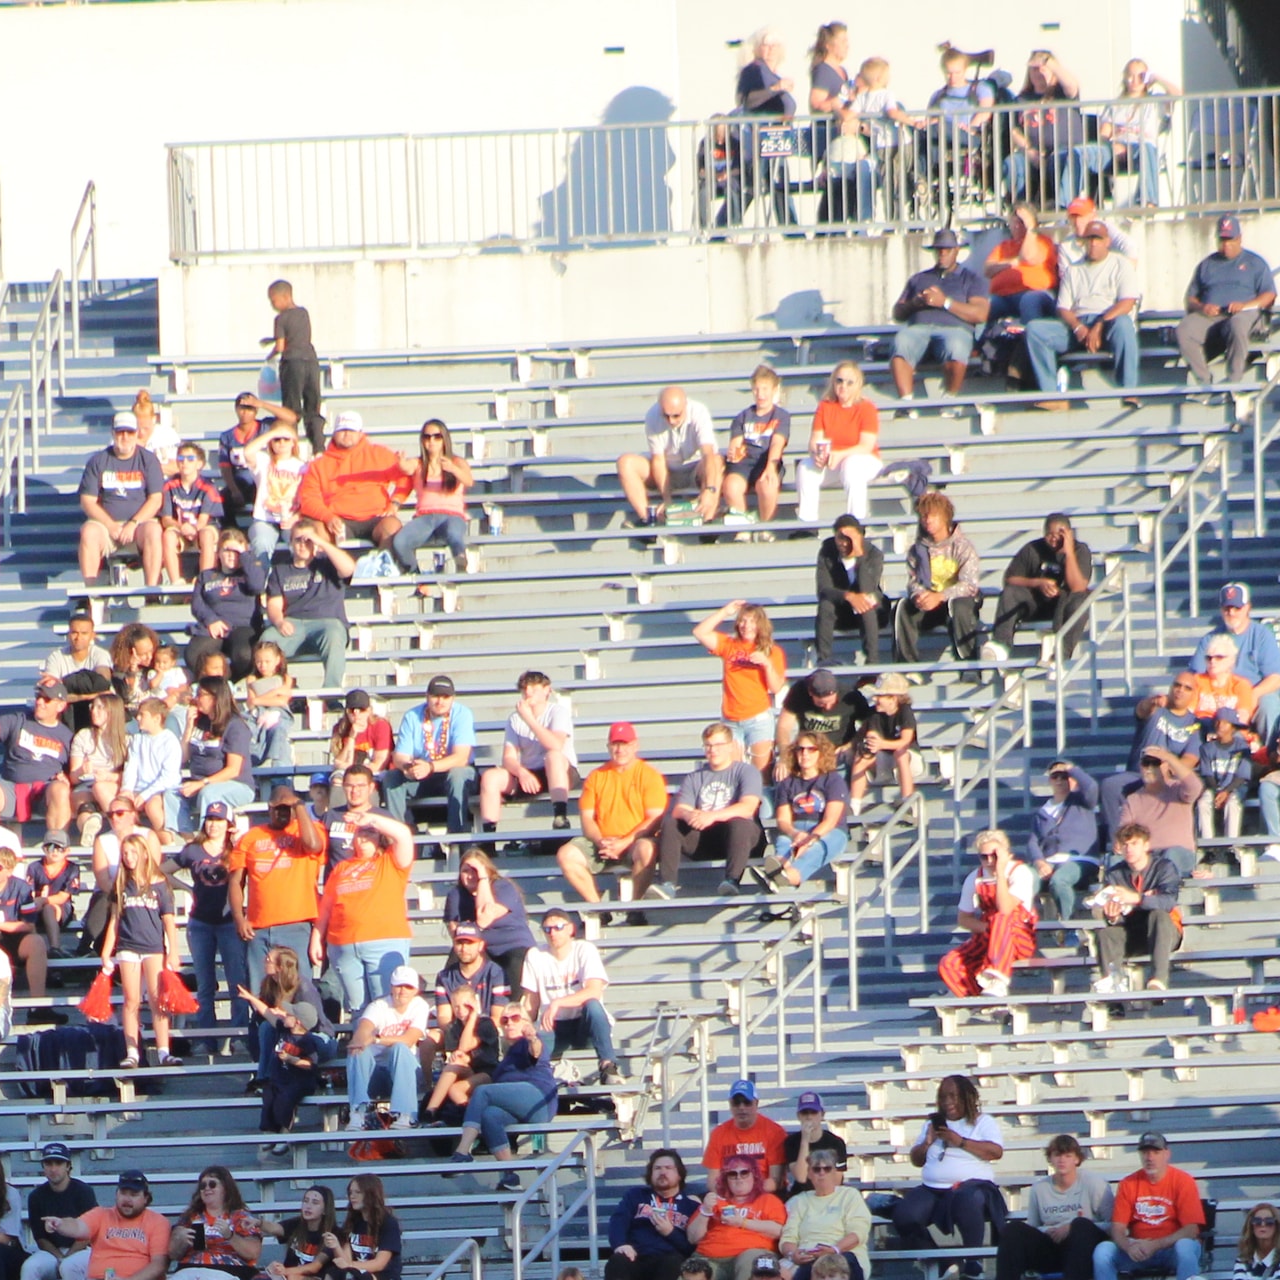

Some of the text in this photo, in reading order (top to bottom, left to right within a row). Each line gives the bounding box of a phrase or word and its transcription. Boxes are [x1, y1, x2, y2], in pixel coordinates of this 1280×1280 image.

[761, 140, 792, 153] 25-36
[1042, 1203, 1083, 1215] VIRGINIA
[106, 1226, 146, 1242] VIRGINIA
